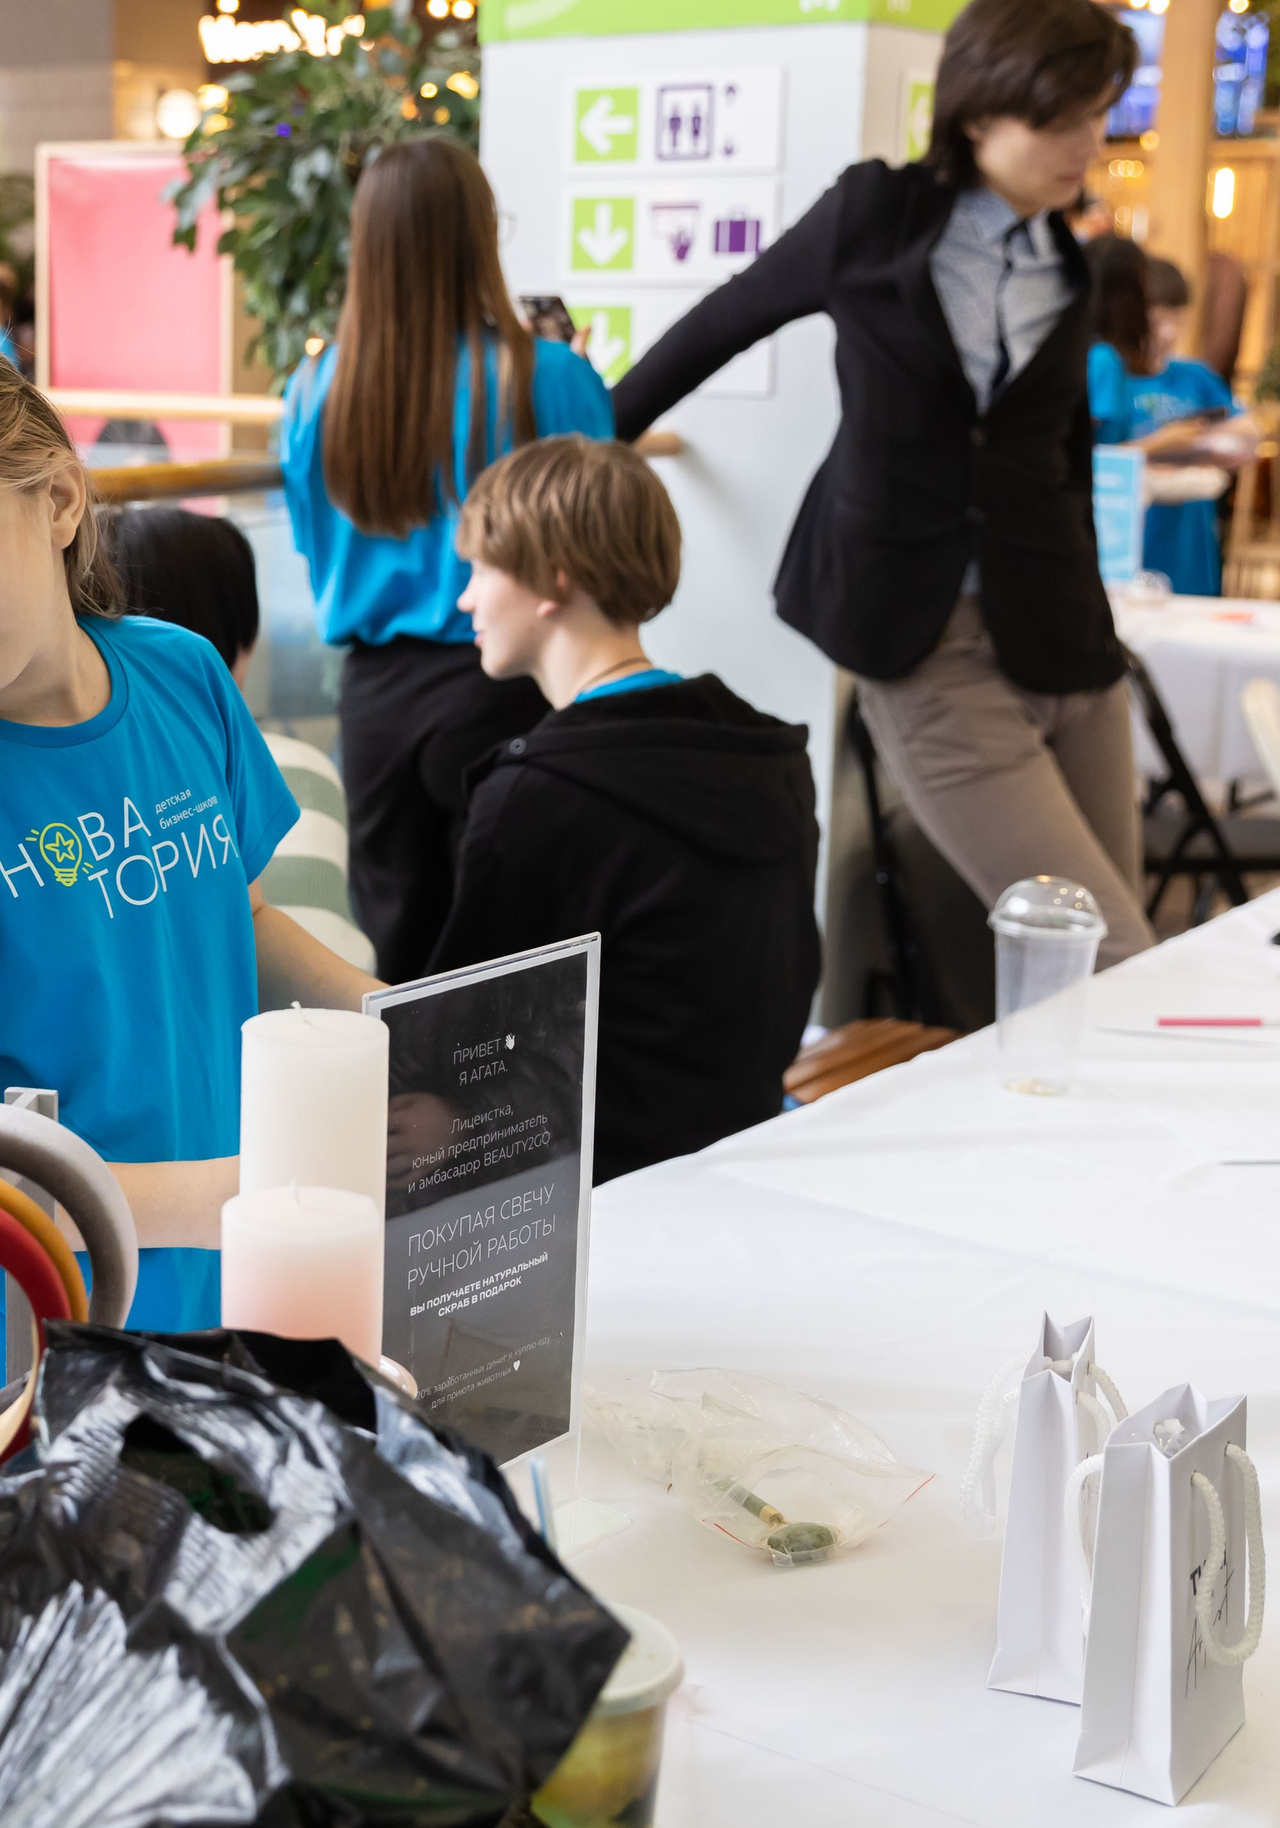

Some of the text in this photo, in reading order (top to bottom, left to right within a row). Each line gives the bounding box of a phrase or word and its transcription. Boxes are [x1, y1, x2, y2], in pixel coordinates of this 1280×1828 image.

[155, 789, 192, 815] детская
[87, 813, 239, 919] ТОРИЯ
[453, 1038, 501, 1065] ПРИВЕТ
[459, 1060, 508, 1086] Я АГАТА.
[412, 1113, 549, 1170] юный предприниматель
[451, 1104, 514, 1134] Лицеистка,
[408, 1131, 552, 1194] и амбасадор BEAUTY2GO
[408, 1183, 555, 1257] ПОКУПАЯ СВЕЧУ
[407, 1214, 556, 1290] РУЧНОЙ РАБОТЫ
[410, 1251, 549, 1317] ВЫ ПОЛУЧАЕТЕ НАТУРАЛЬНЫЙ
[438, 1276, 522, 1317] СКРАБ В ПОДАРОК
